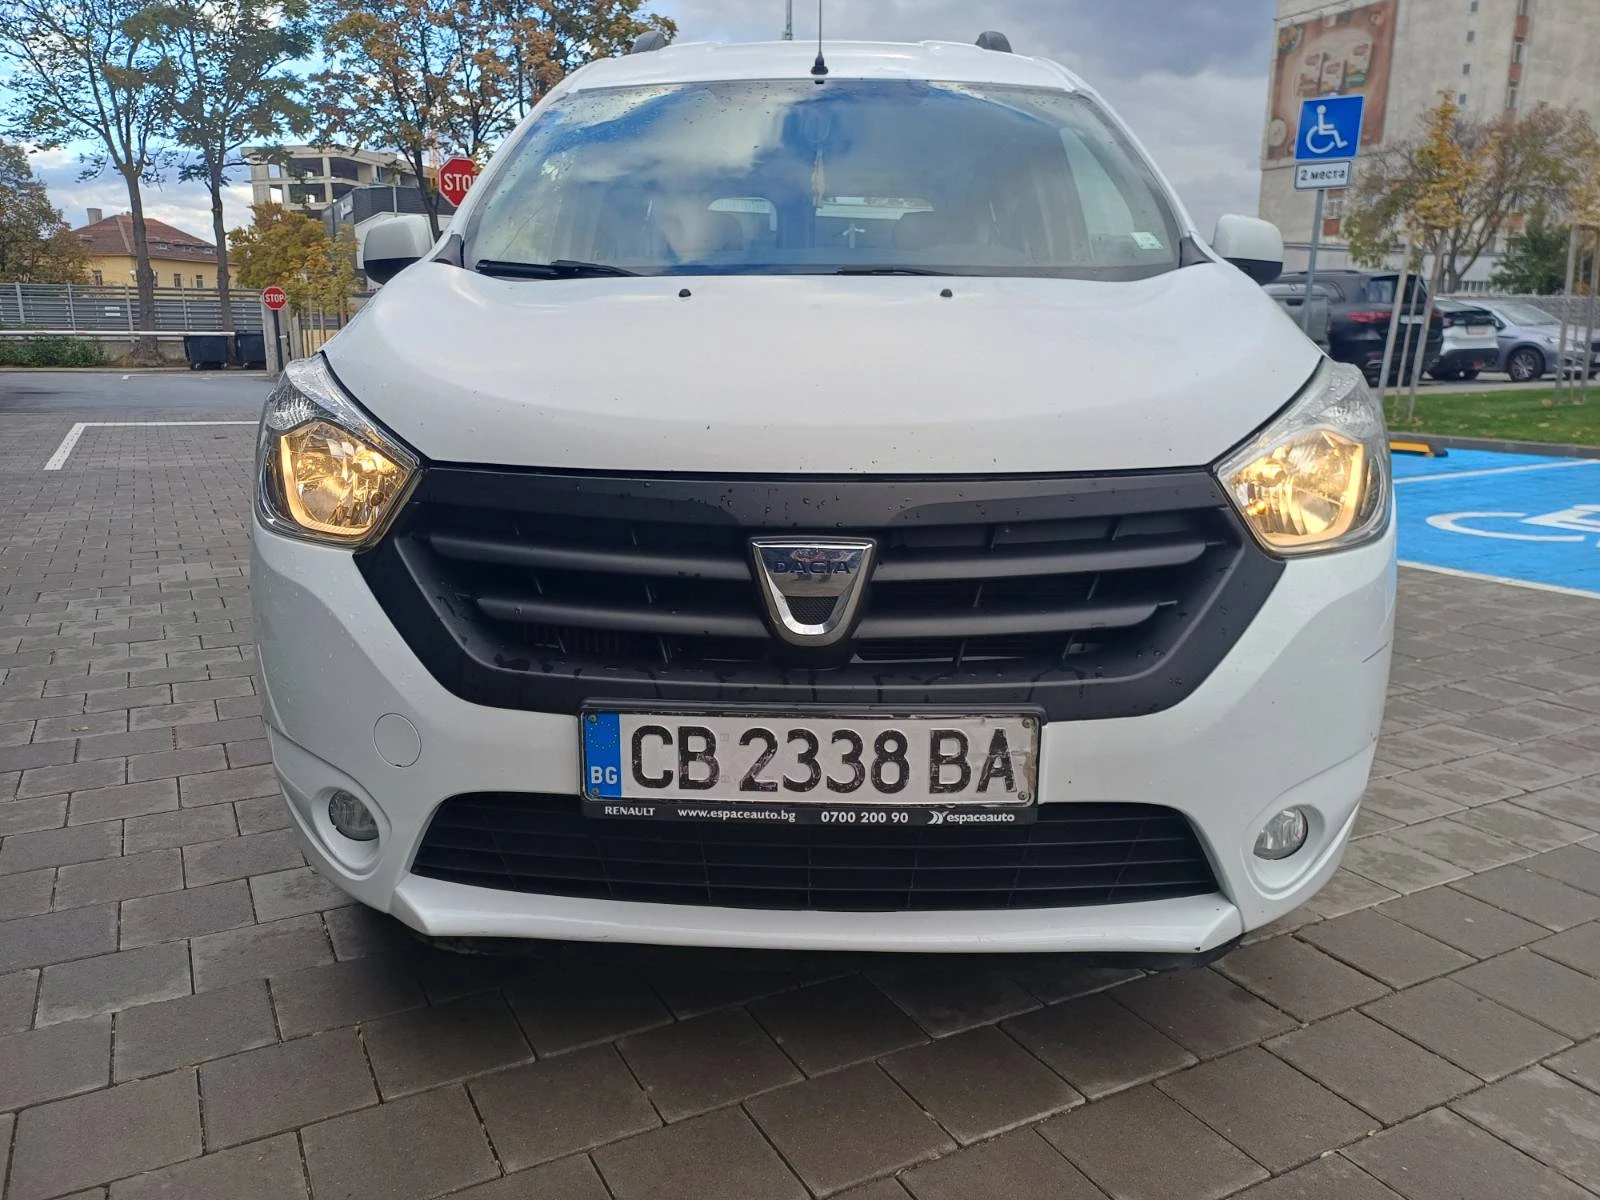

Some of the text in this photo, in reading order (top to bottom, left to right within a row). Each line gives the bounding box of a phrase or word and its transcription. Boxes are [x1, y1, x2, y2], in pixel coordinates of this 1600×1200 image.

[1300, 169, 1345, 181] 2 места
[264, 294, 284, 303] STOP
[774, 561, 851, 574] DACIA
[631, 725, 1018, 794] CB 2338 BA
[590, 766, 618, 785] BG
[604, 806, 656, 817] RENAULT
[677, 808, 796, 823] www.espaceauto.bg
[820, 811, 909, 824] 0700 200 90
[946, 813, 1015, 825] espaceauto
